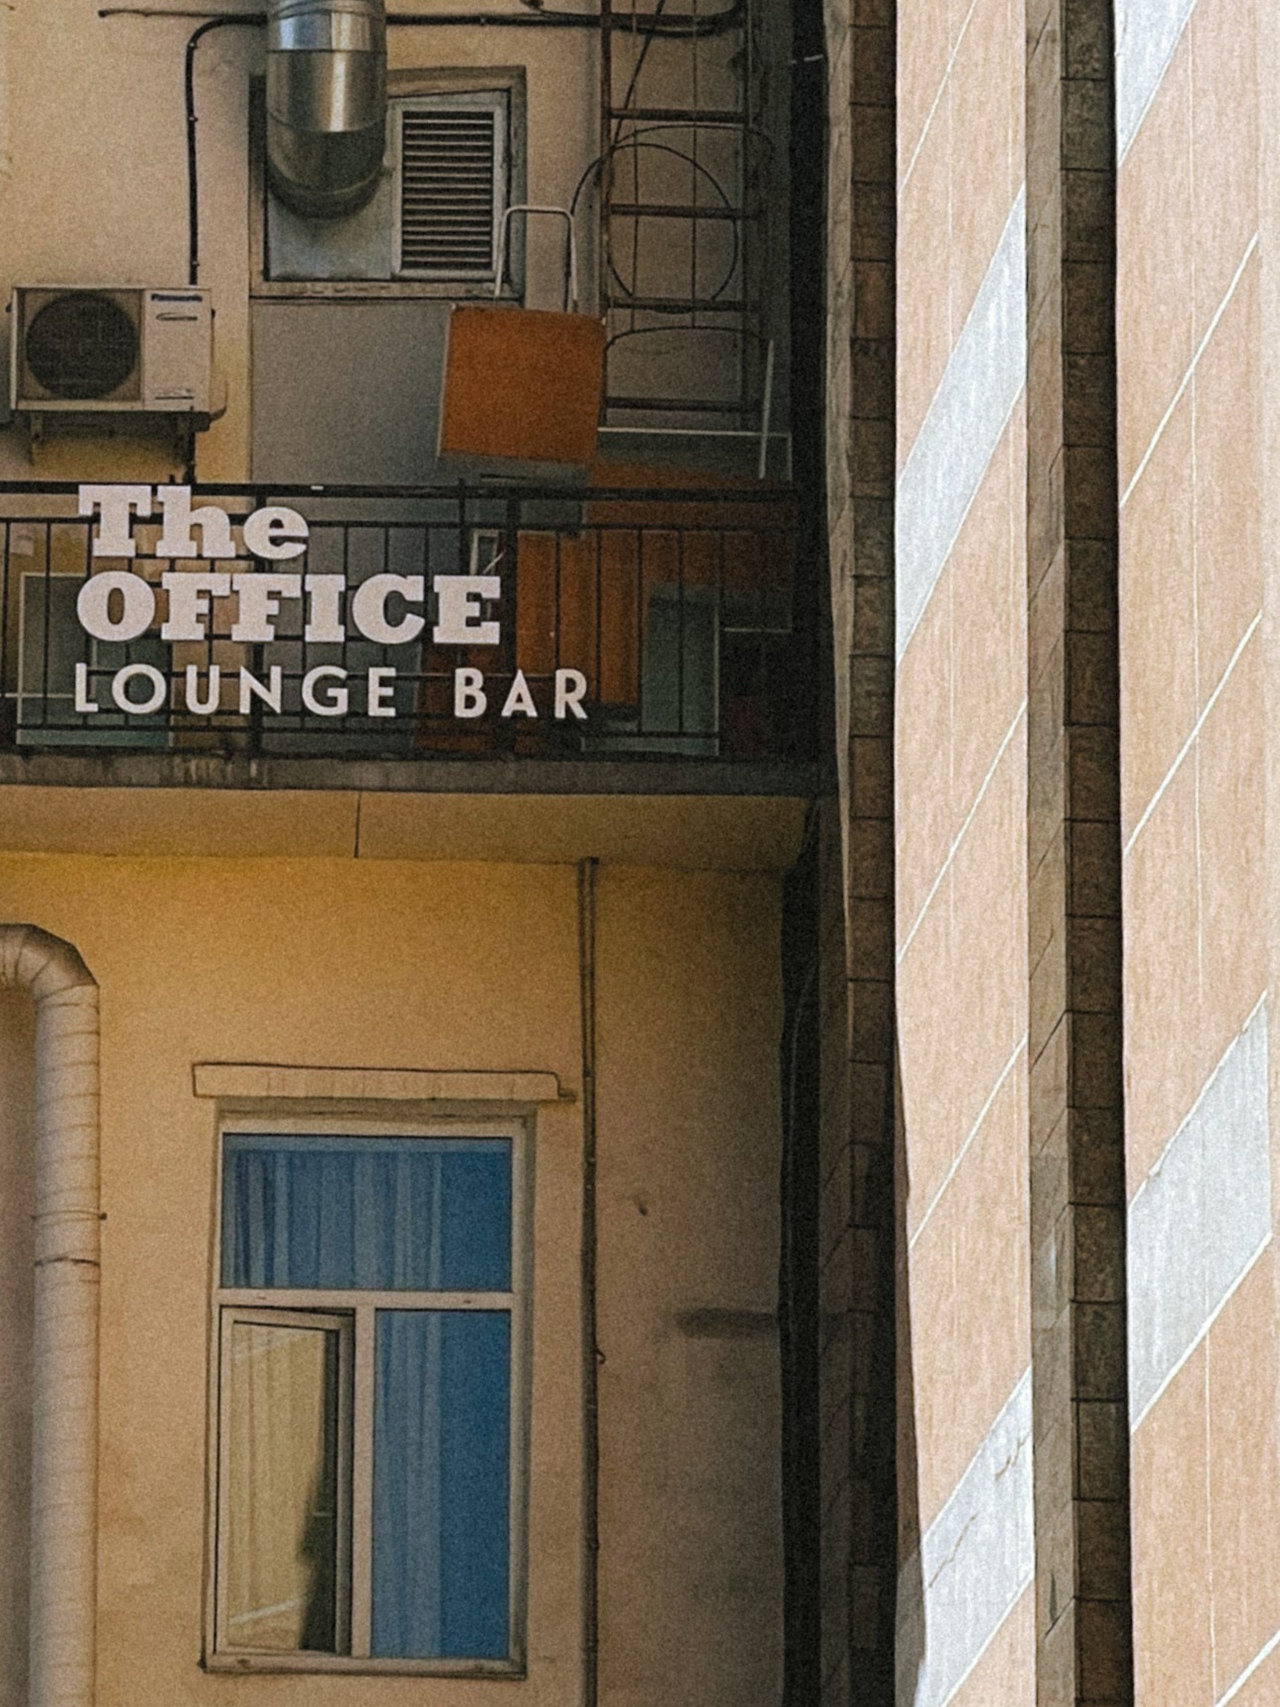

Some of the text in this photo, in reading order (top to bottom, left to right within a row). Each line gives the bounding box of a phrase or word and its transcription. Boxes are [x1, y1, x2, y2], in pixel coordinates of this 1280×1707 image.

[78, 485, 310, 560] The
[77, 571, 502, 645] OFFICE
[75, 662, 588, 720] LOUNGE BAR
